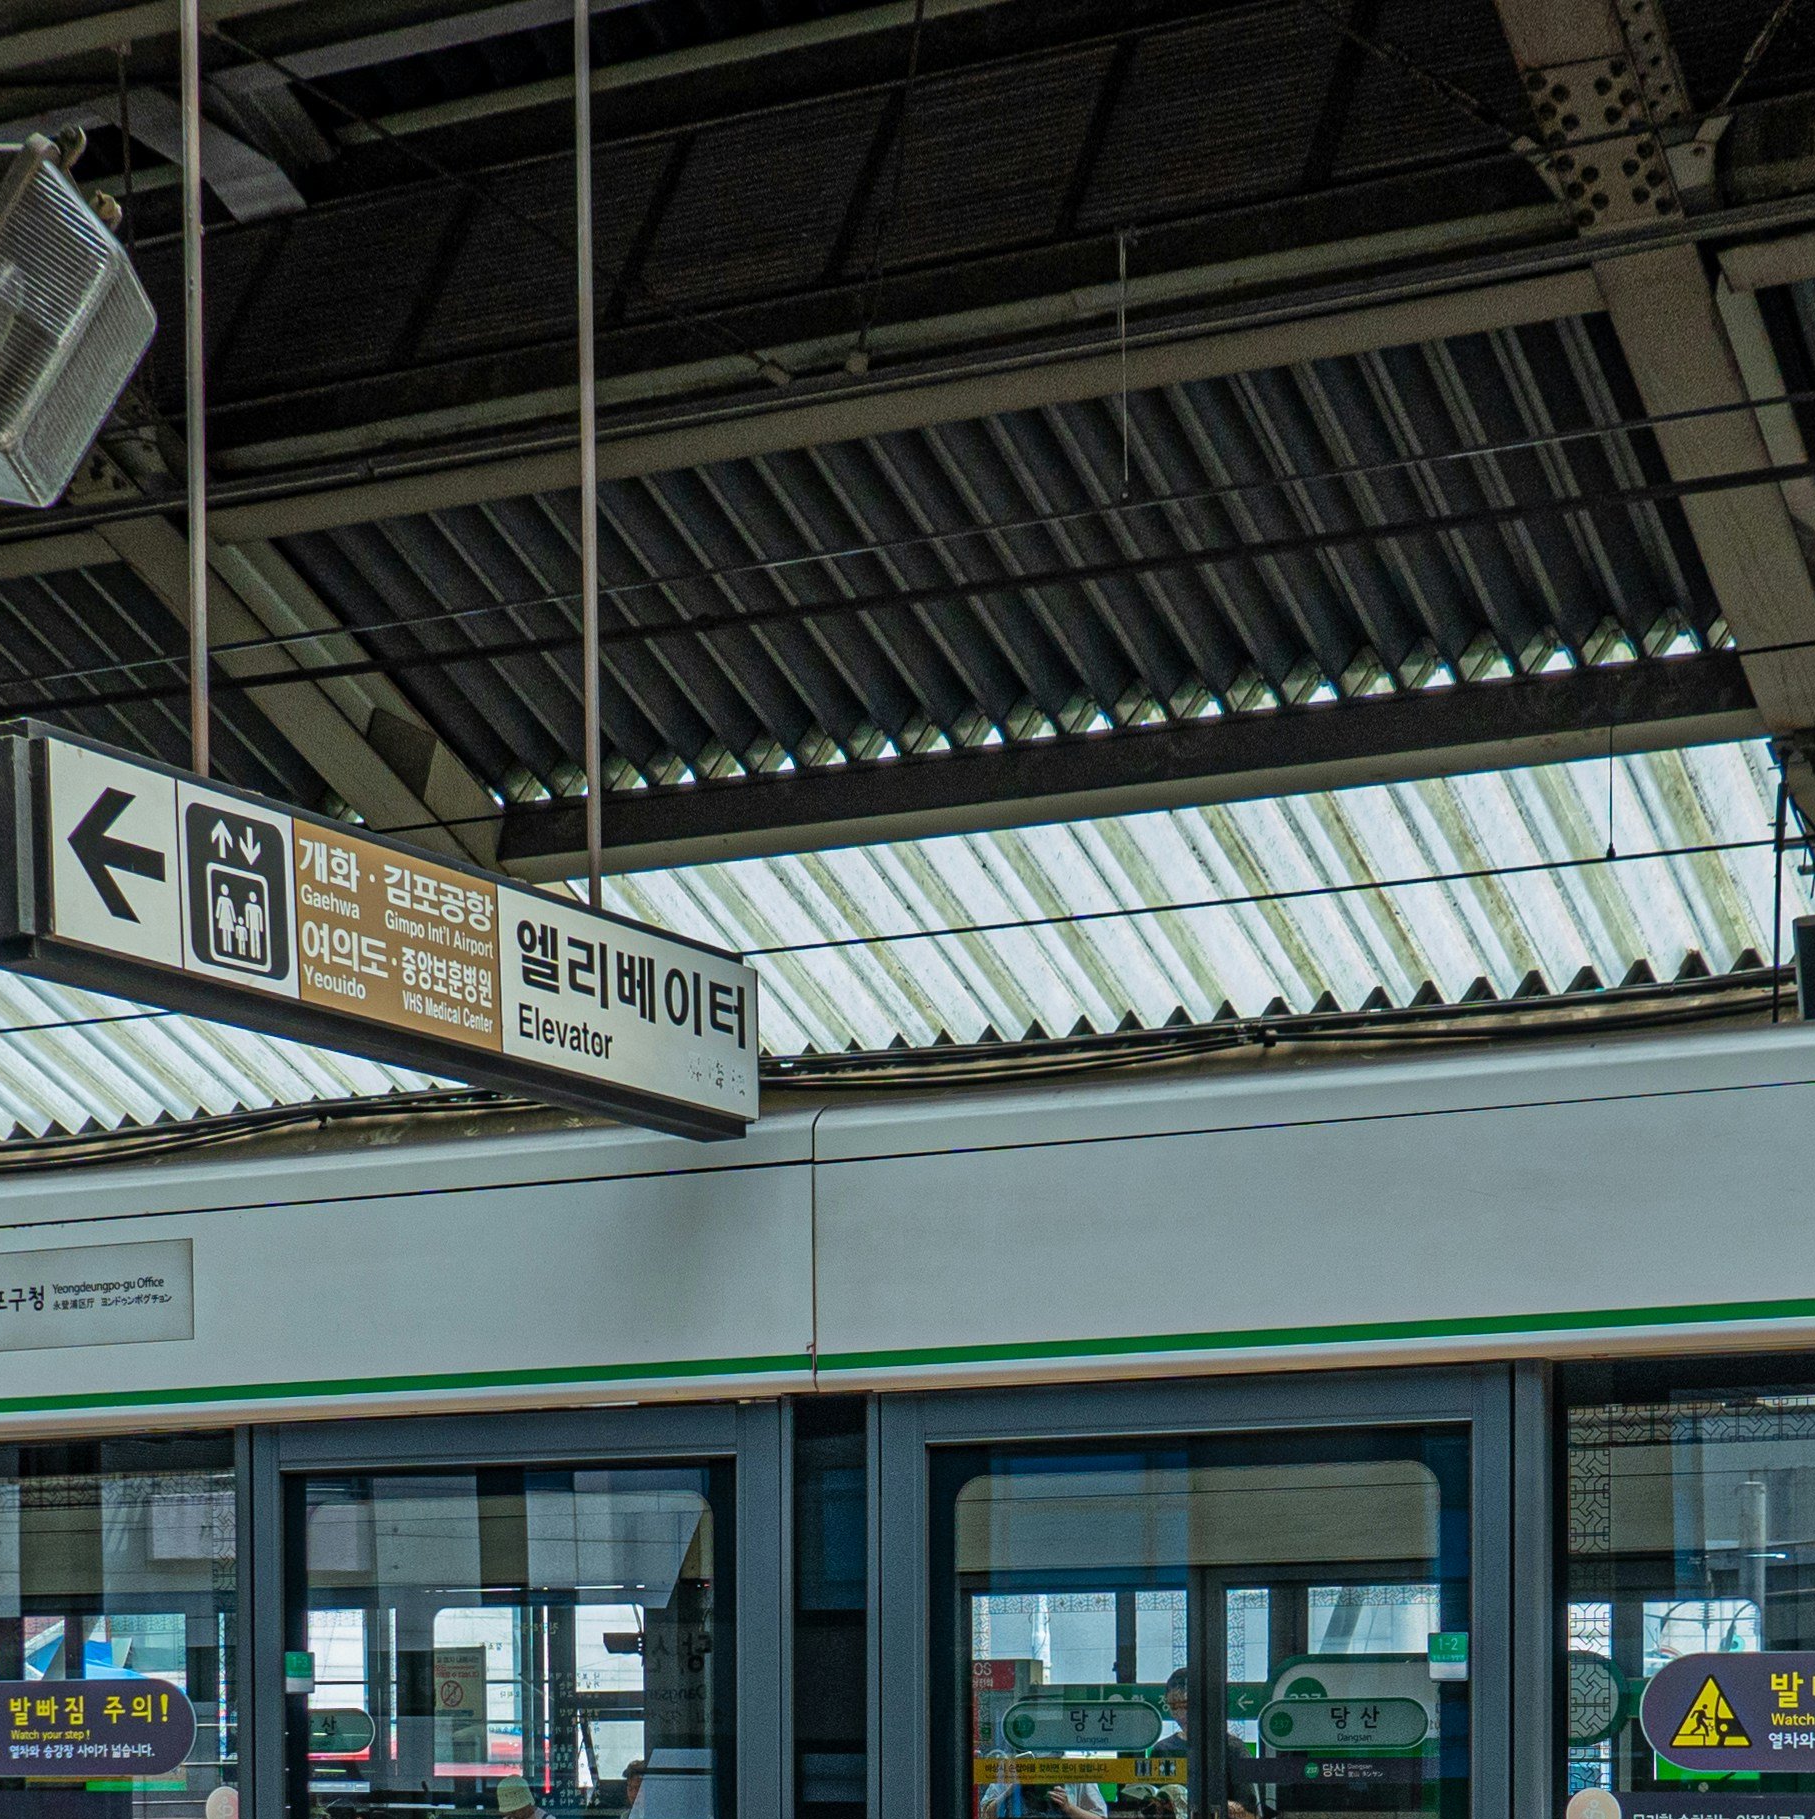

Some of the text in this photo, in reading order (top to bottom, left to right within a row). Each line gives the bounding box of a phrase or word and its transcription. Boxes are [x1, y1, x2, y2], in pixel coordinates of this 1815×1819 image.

[298, 838, 495, 933] 개화 김포공항
[300, 884, 360, 920] Gaehwa
[385, 910, 426, 939] Gimpo
[454, 929, 494, 959] Airport
[302, 920, 493, 1009] 여의도 중앙보훈병원
[516, 919, 747, 1050] 엘리베이터
[303, 964, 494, 1034] Yeouido VHS Medical Center
[518, 1002, 613, 1060] Elevator
[52, 1276, 164, 1296] Yeongdeungpo-gu Office
[1438, 1637, 1458, 1650] 1-2
[292, 1656, 309, 1668] 1-3
[9, 1693, 170, 1726] 발빠짐 주의!
[1771, 1713, 1815, 1726] Watch
[10, 1729, 40, 1741] Watch
[42, 1730, 62, 1742] your
[1076, 1735, 1109, 1745] Dangsan
[1337, 1733, 1372, 1743] Dangsan
[1768, 1731, 1815, 1750] 열차와
[9, 1743, 156, 1760] 열차와 승강장 사이가 넓습니다.
[1322, 1763, 1345, 1777] 당산
